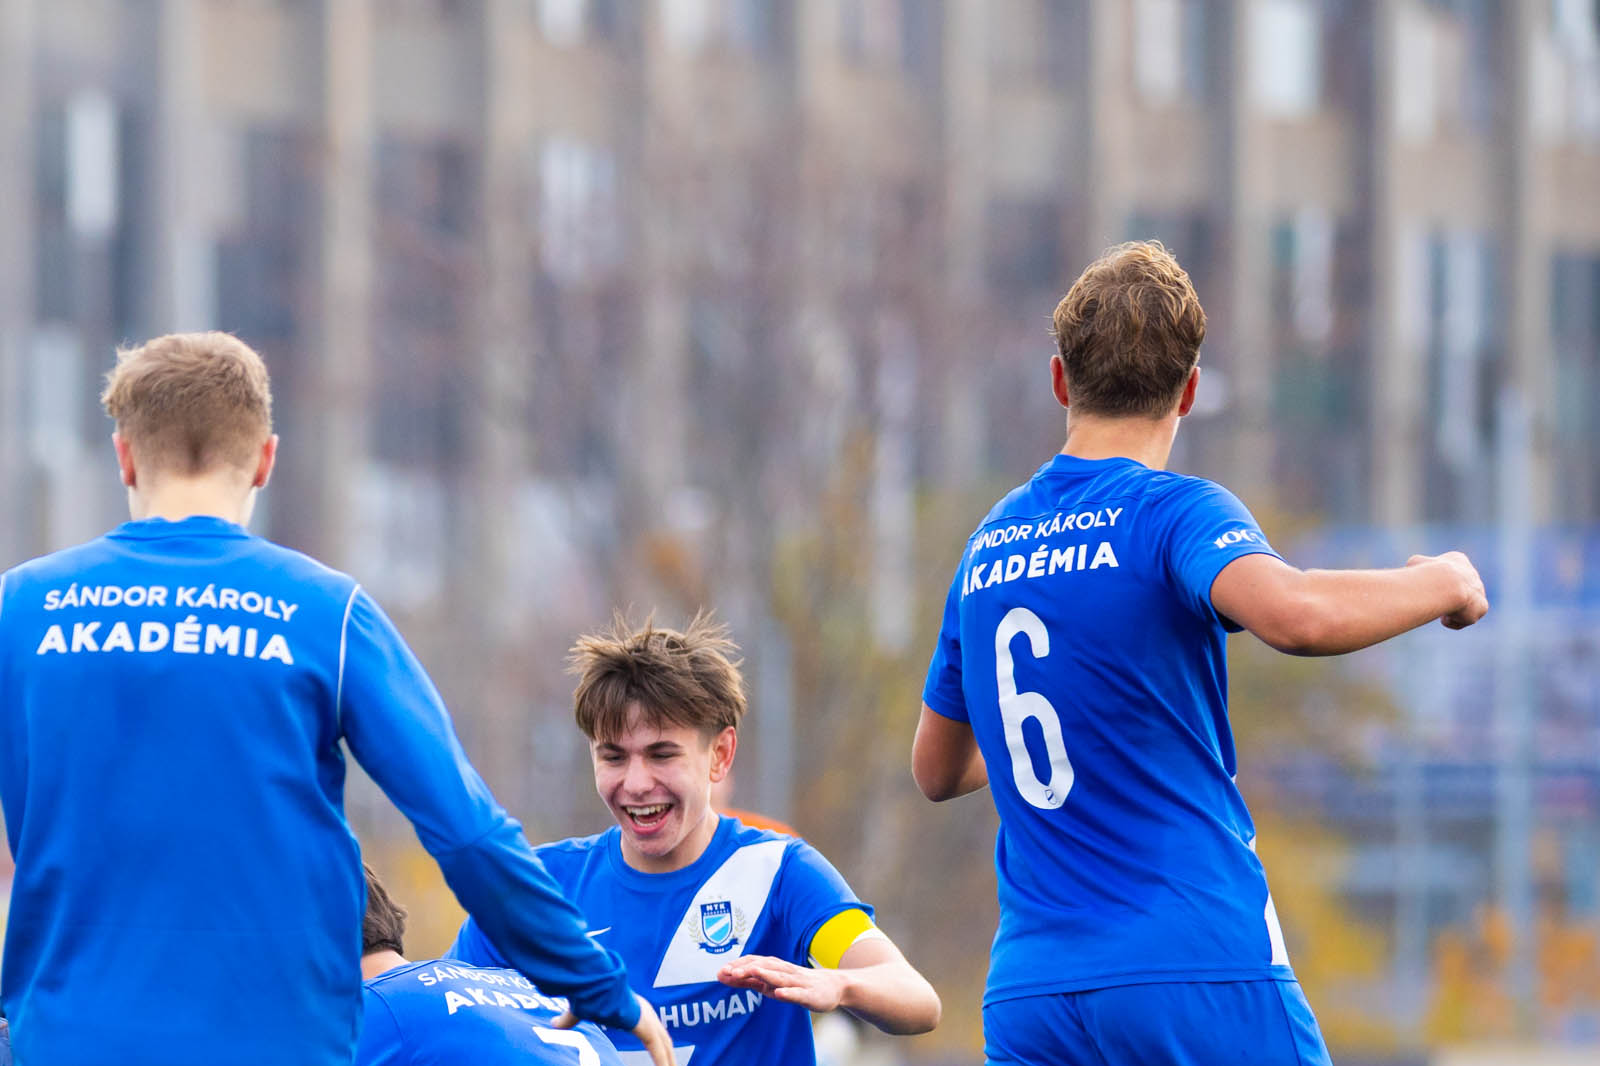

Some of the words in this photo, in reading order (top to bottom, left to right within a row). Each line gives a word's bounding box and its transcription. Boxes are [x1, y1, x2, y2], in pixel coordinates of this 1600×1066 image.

[1034, 507, 1123, 539] KÁROLY
[43, 583, 167, 611] SÁNDOR
[176, 584, 298, 622] KÁROLY
[36, 614, 294, 665] AKADÉMIA
[995, 606, 1075, 810] 6
[658, 989, 763, 1029] HUMAN
